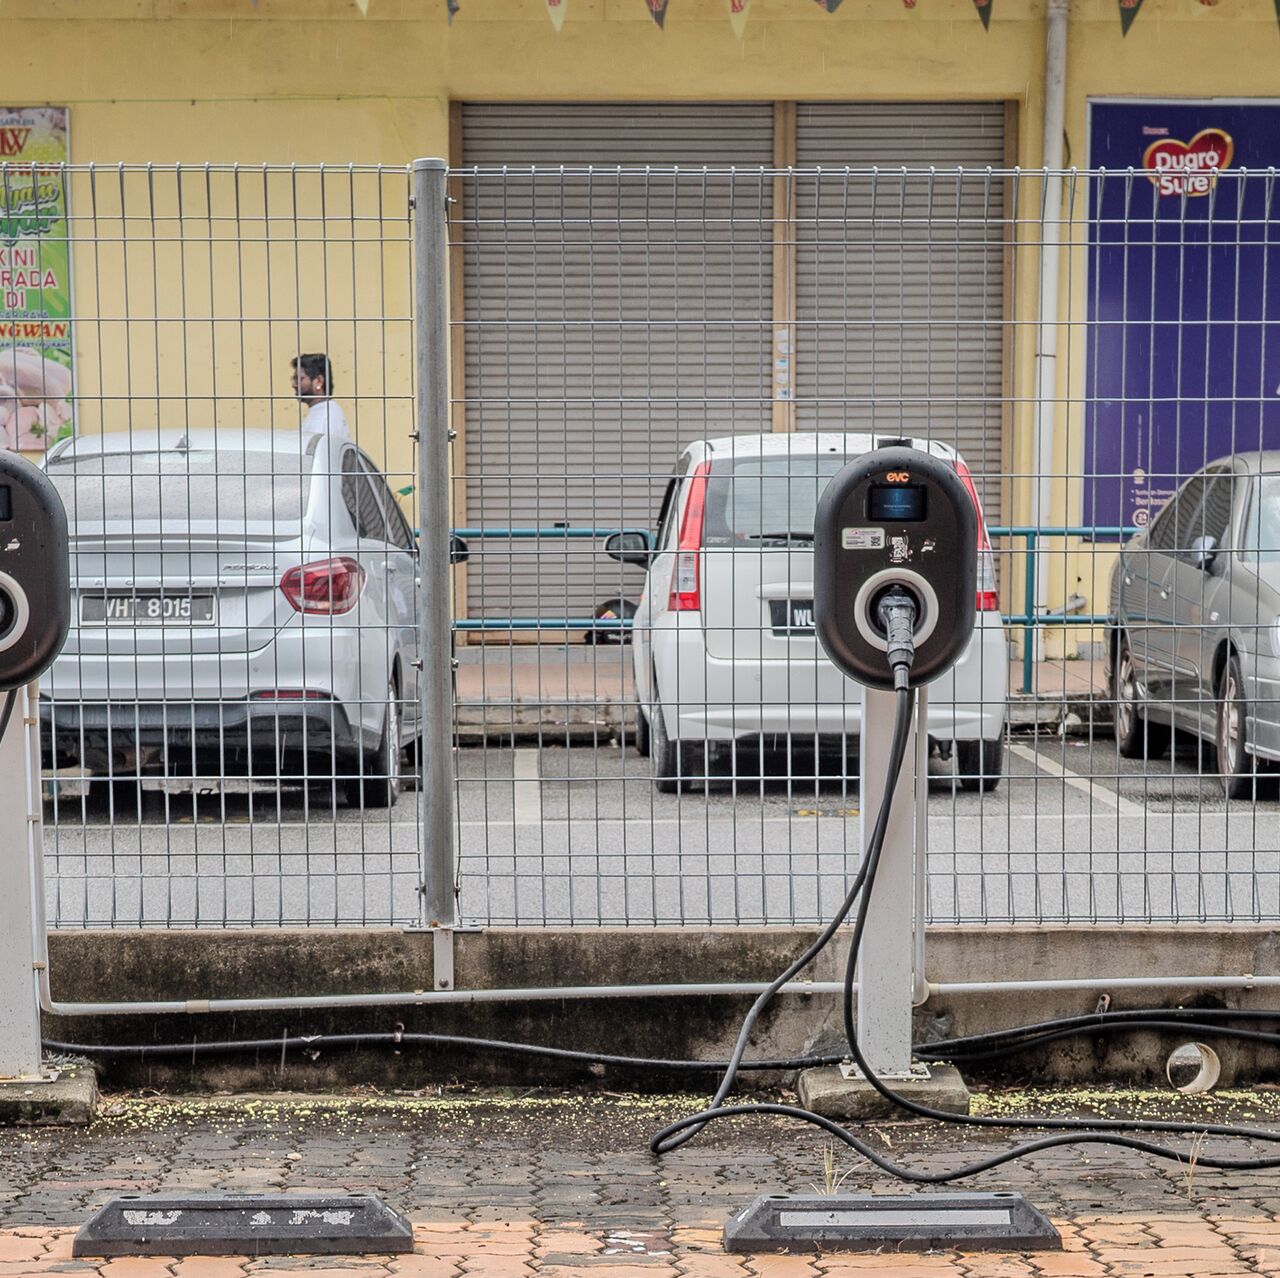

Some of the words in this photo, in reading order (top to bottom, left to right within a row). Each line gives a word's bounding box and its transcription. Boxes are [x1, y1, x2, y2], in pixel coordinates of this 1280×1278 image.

[1155, 151, 1220, 170] Dugro
[1160, 176, 1209, 196] Sure
[6, 291, 25, 309] DI
[886, 472, 910, 482] evc
[105, 598, 140, 618] VHT
[147, 598, 191, 618] 8015
